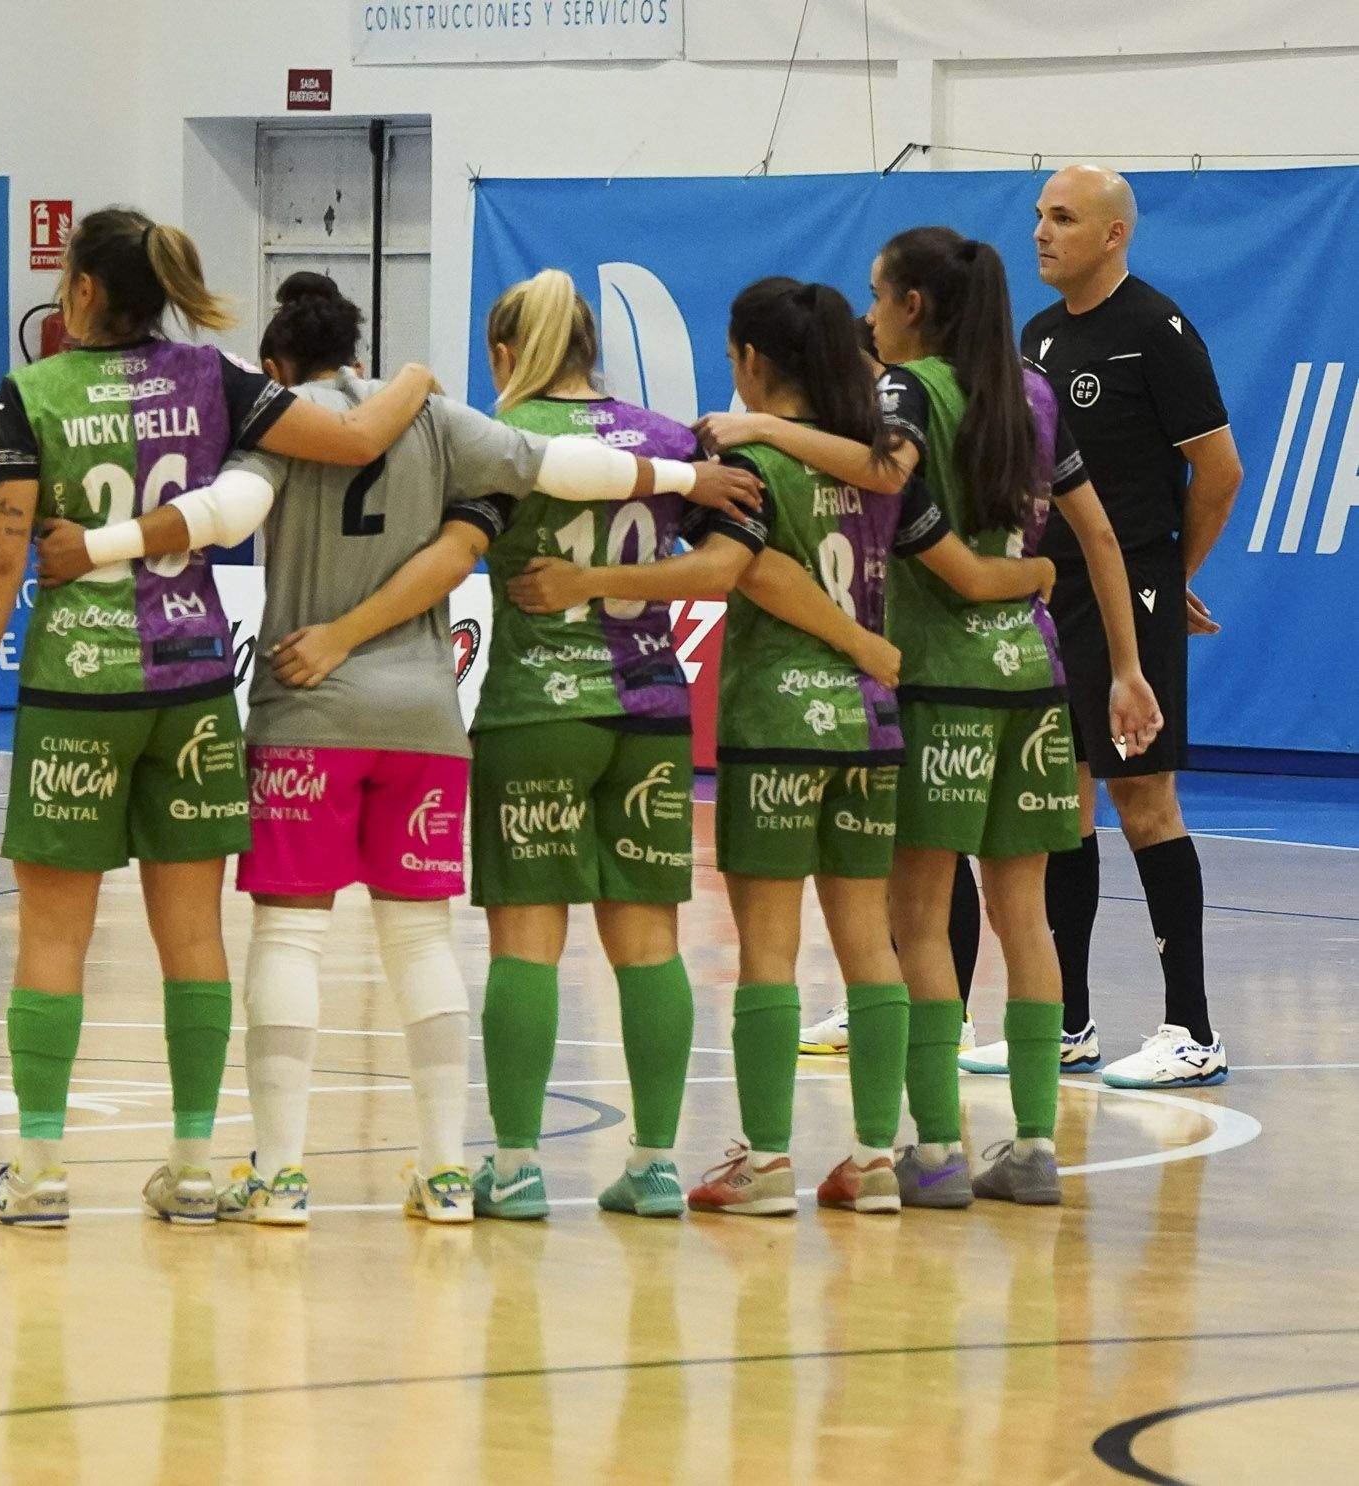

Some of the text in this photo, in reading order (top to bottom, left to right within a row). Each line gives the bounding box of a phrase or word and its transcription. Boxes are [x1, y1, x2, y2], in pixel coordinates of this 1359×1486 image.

[365, 0, 668, 31] CONSTRUCCIONES Y SERVICIOS
[1077, 380, 1095, 389] RF
[1076, 390, 1093, 399] EF
[62, 406, 200, 447] VICKY BELLA
[342, 454, 386, 537] 2
[41, 735, 110, 754] CLINICAS
[506, 777, 573, 795] CLINICAS
[33, 803, 99, 822] DENTAL
[250, 806, 312, 821] DENTAL
[512, 841, 578, 860] DENTAL
